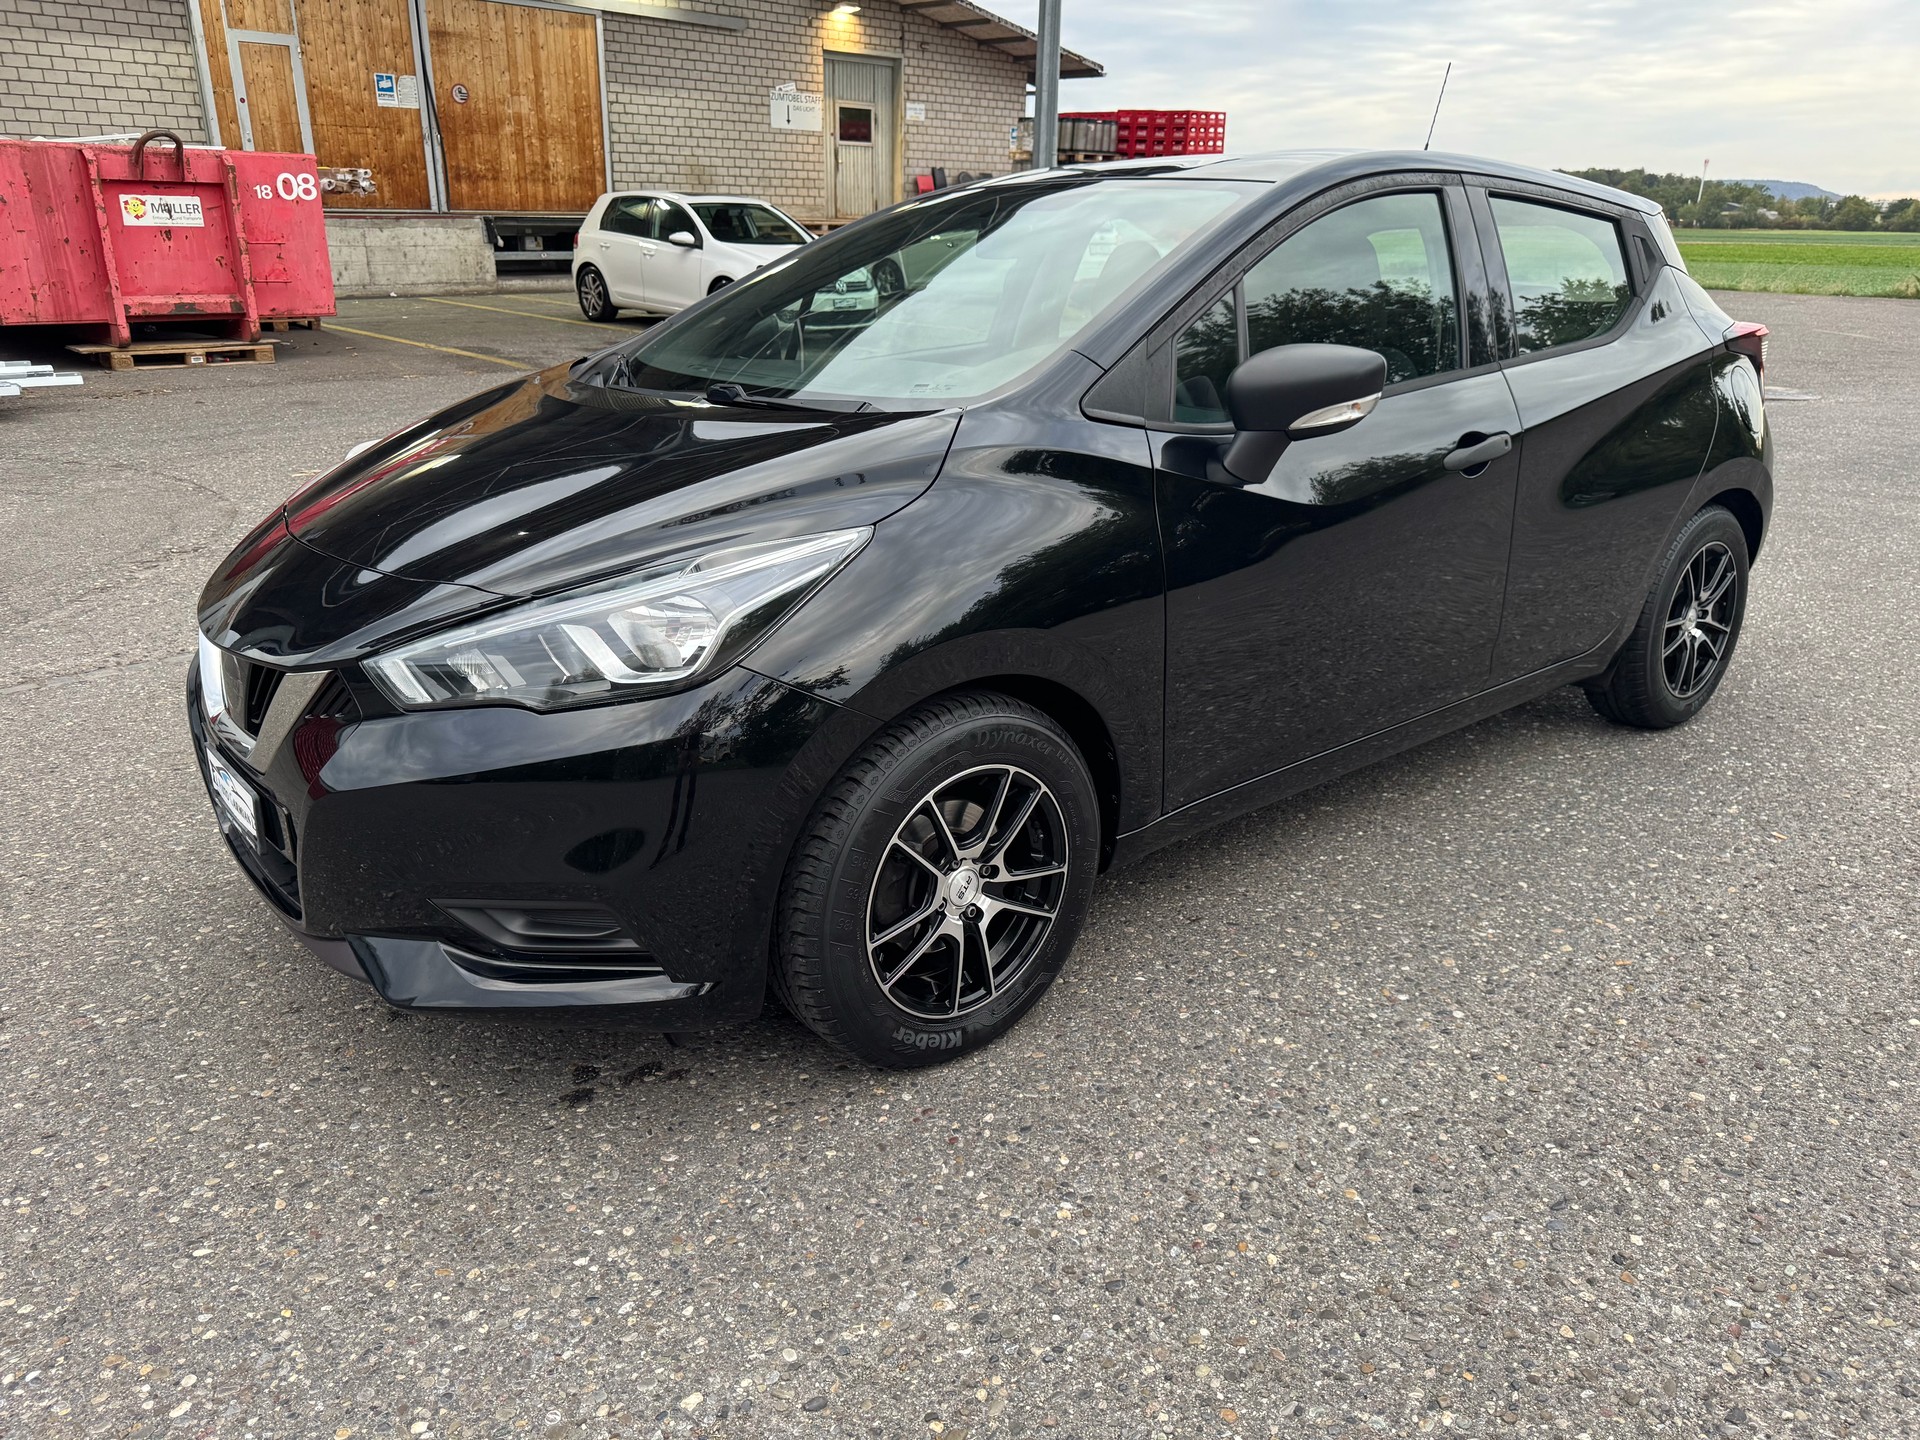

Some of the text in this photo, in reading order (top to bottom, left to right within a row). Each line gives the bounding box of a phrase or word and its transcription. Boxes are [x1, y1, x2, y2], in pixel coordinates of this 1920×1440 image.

[770, 91, 822, 104] ZUMTOBEL STAFF
[253, 172, 318, 201] 18 08
[974, 729, 1056, 755] Dynaxer
[891, 1026, 963, 1050] Kleber
